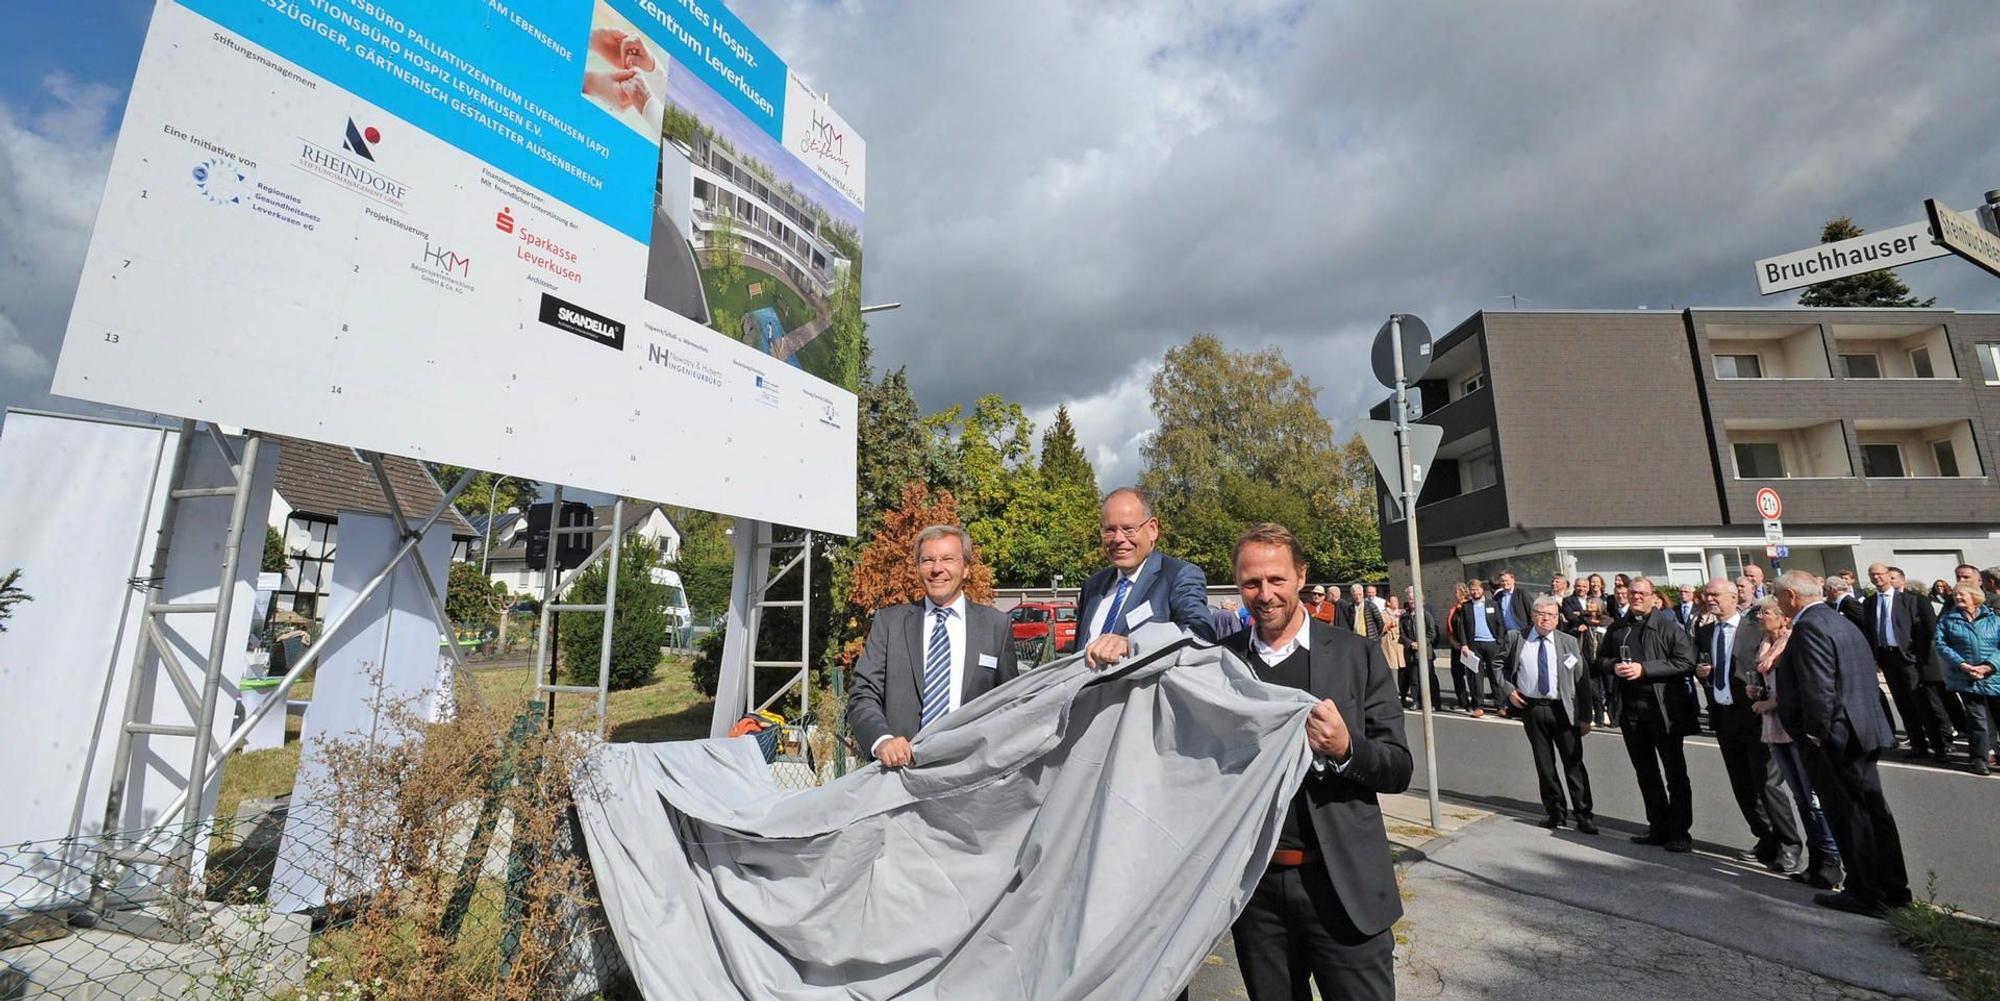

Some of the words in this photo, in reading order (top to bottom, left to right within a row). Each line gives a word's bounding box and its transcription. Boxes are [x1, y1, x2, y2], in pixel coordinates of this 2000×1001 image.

[489, 0, 508, 17] AM
[510, 11, 574, 62] LEBENSENDE
[712, 18, 758, 68] Hospiz-
[213, 32, 317, 91] Stiftungsmanagement
[634, 0, 702, 57] zentrum
[705, 47, 774, 118] Leverkusen
[261, 0, 351, 51] SZÜGIGER,
[355, 44, 449, 105] GÄRTNERISCH
[451, 99, 524, 147] GESTALTETER
[526, 140, 603, 191] AUSSENBEREICH
[403, 48, 450, 84] HOSPIZ
[452, 77, 523, 127] LEVERKUSEN
[525, 120, 543, 137] E.V.
[408, 28, 522, 105] PALLIATIVZENTRUM
[523, 100, 589, 144] LEVERKUSEN
[586, 137, 610, 159] (APZ)
[163, 124, 188, 141] Eine
[190, 135, 237, 161] Initiative
[238, 155, 257, 169] von
[812, 108, 842, 155] HKM
[302, 145, 407, 199] RHEINDORF
[141, 189, 148, 199] 1
[255, 192, 321, 223] Gesundheitsnetz
[257, 182, 302, 204] Regionales
[252, 203, 301, 226] Leverkusen
[302, 223, 314, 231] eG
[365, 207, 430, 241] Projektsteuerung
[122, 259, 131, 269] 7
[423, 241, 470, 279] HKM
[519, 227, 578, 264] Sparkasse
[1765, 233, 1919, 284] Bruchhauser
[353, 264, 360, 273] 2
[517, 246, 582, 283] Leverkusen
[104, 331, 120, 344] 13
[341, 323, 349, 333] 8
[330, 385, 343, 395] 14
[668, 362, 722, 388] INGENIEURBÜRO
